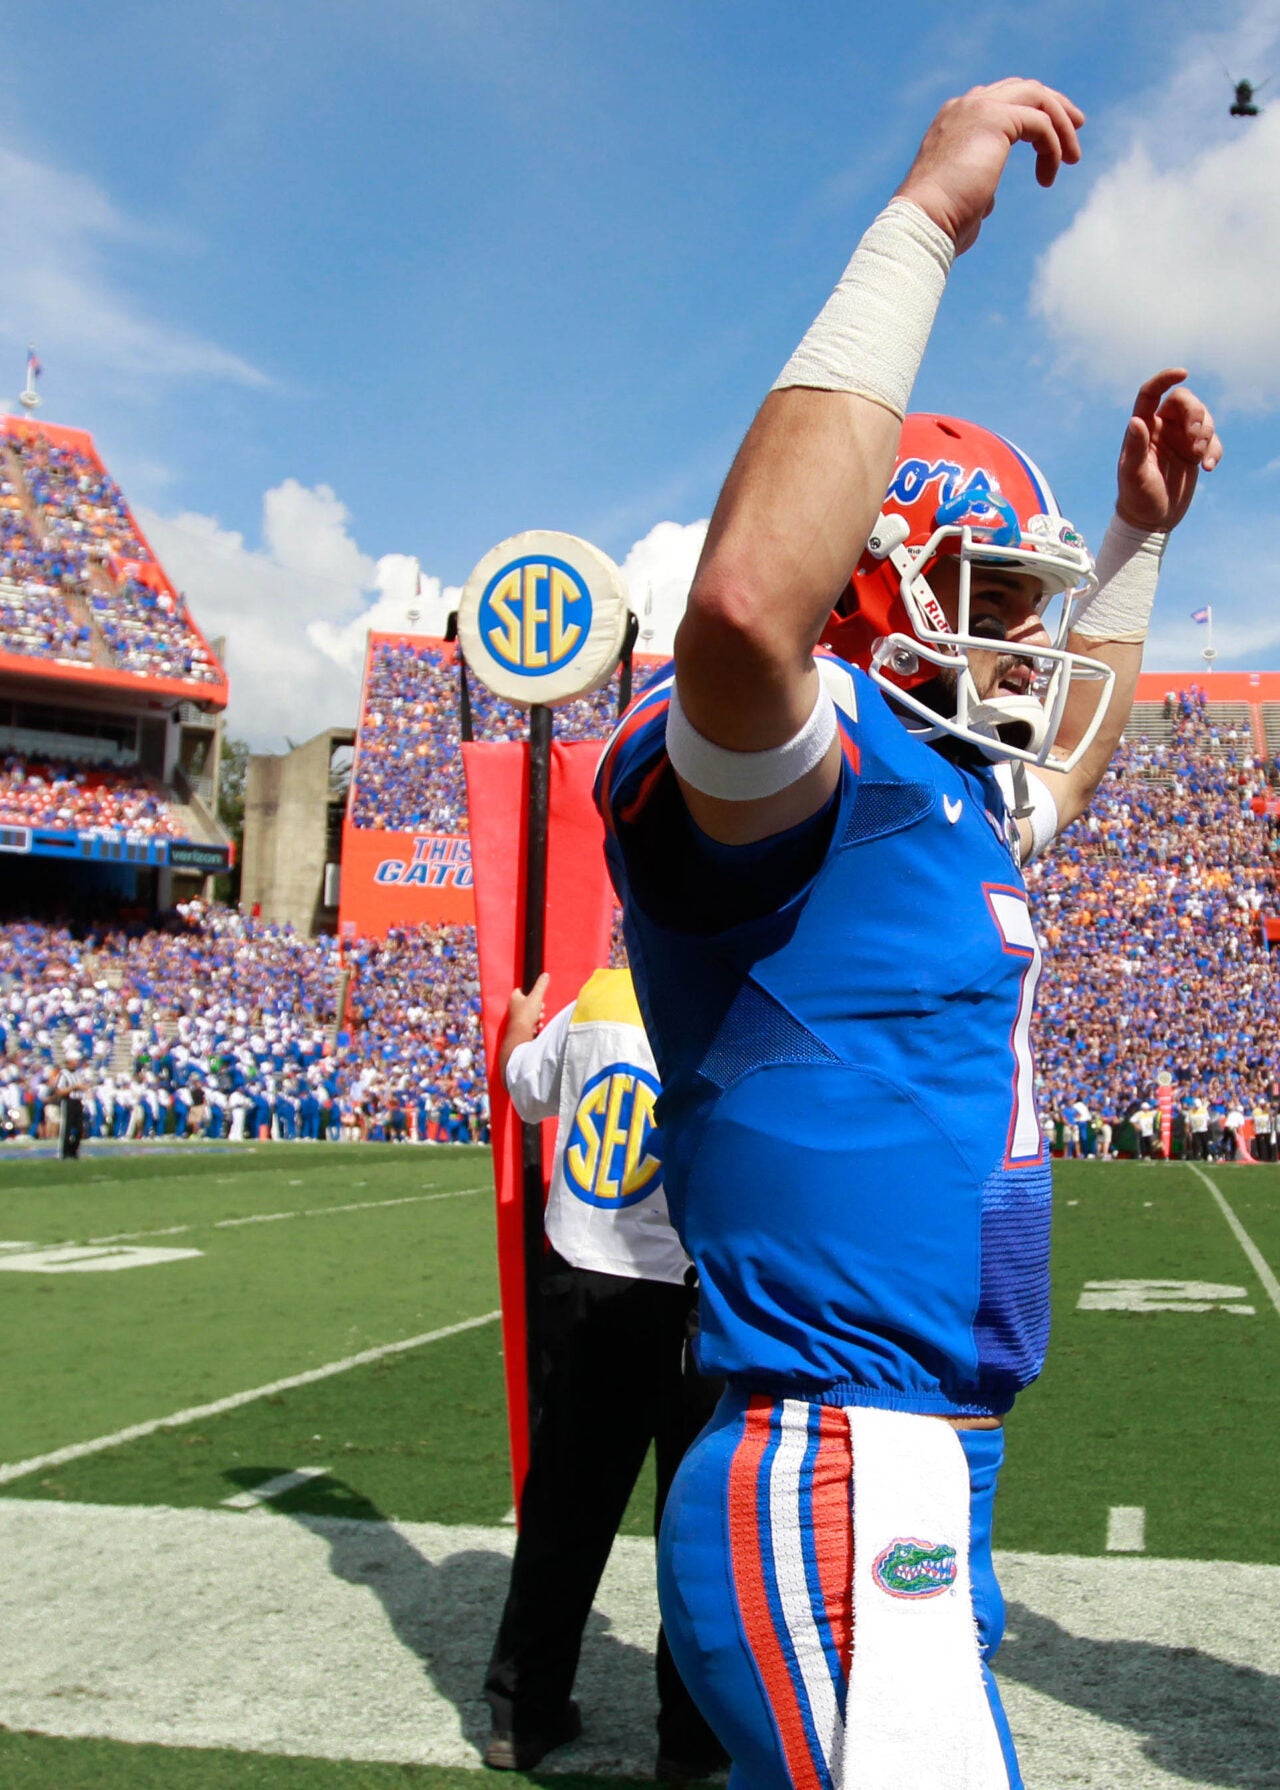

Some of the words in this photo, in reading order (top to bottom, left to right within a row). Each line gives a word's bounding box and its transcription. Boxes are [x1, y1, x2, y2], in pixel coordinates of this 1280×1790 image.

[884, 458, 1001, 514] ors
[488, 563, 582, 668] SEC
[172, 847, 223, 865] verizon
[412, 836, 472, 862] THIS
[373, 859, 474, 889] GATO
[567, 1072, 662, 1198] SEC
